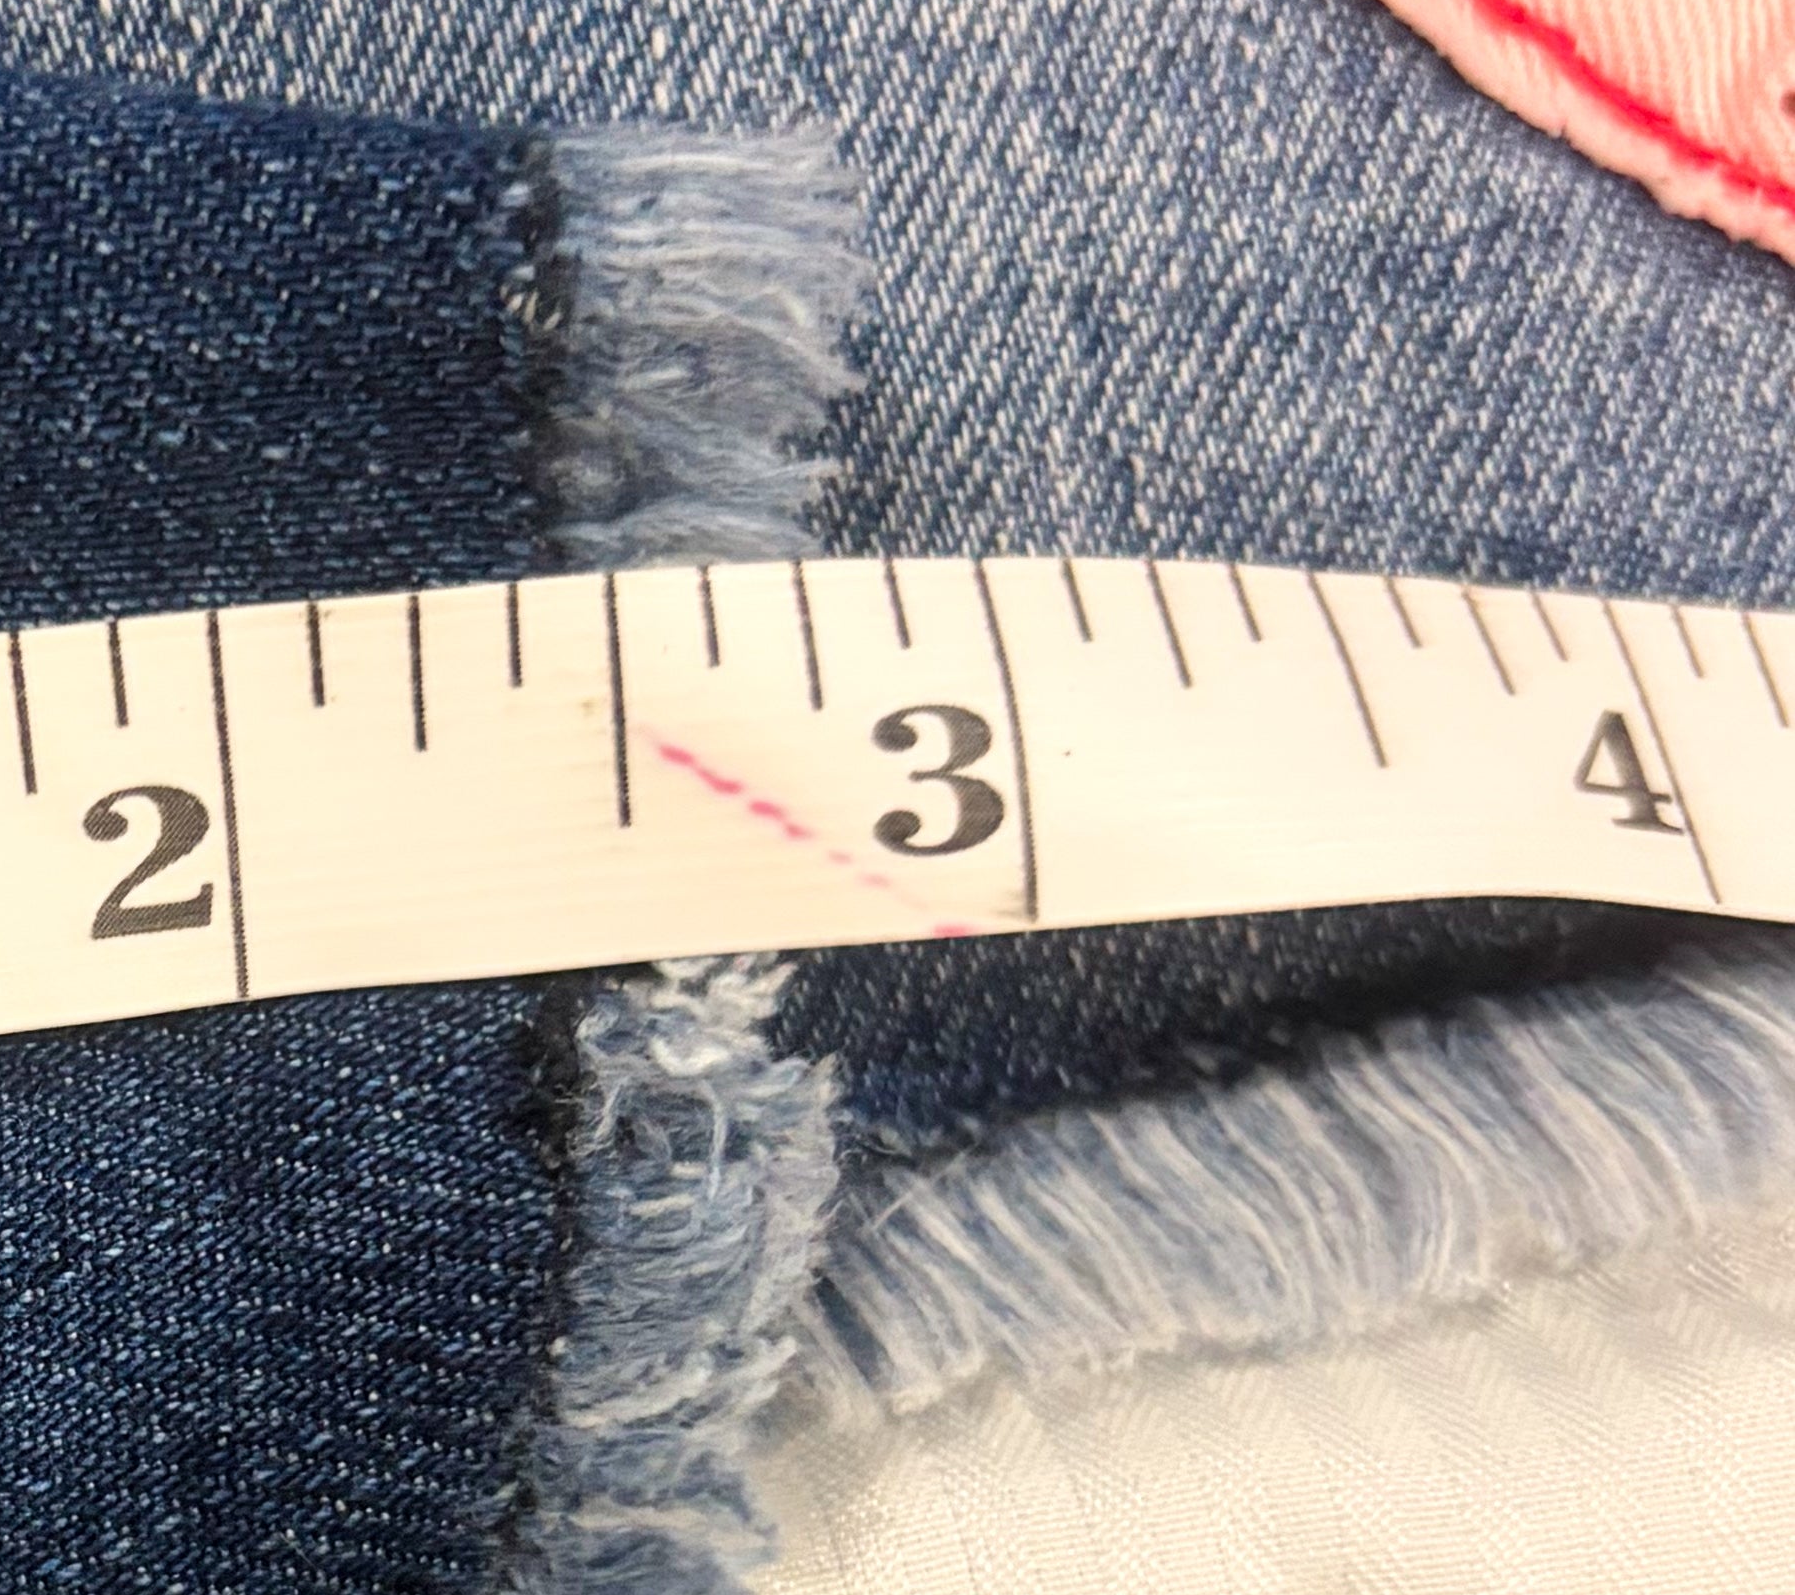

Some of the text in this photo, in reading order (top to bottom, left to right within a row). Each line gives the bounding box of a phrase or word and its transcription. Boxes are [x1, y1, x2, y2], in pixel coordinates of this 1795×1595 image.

[871, 703, 1006, 857] 3
[1574, 709, 1687, 836] 4
[81, 784, 213, 940] 2
